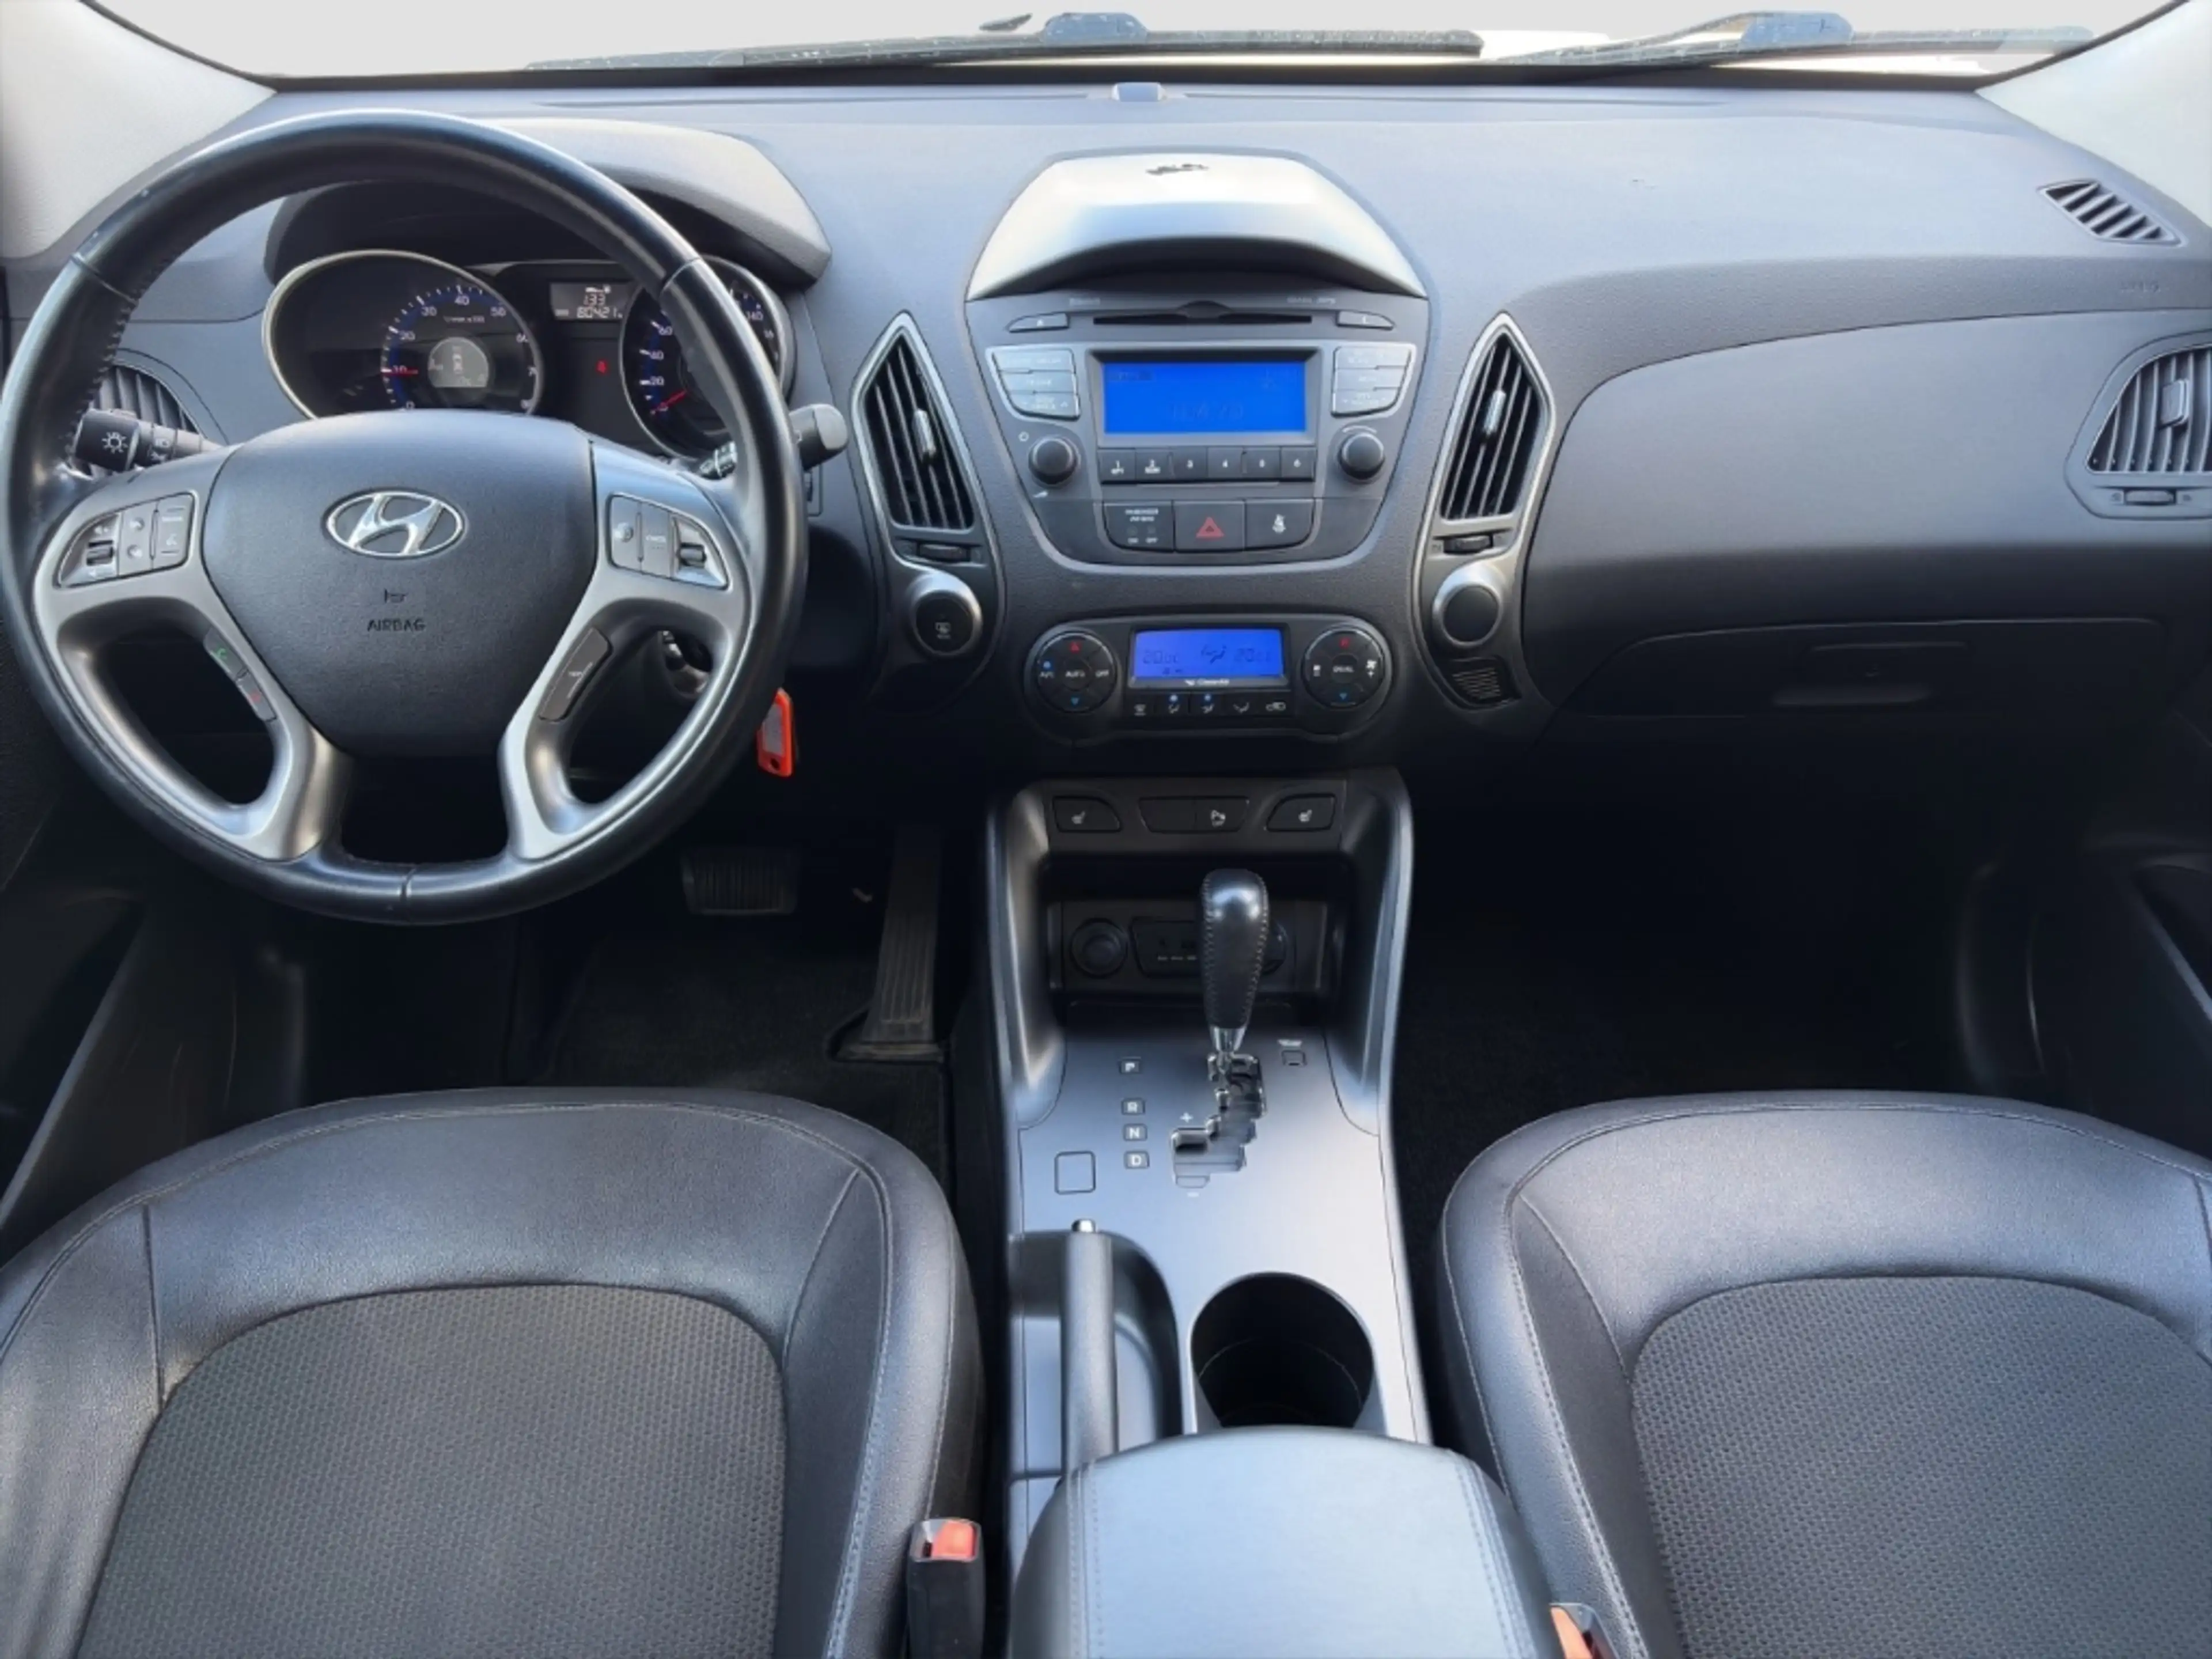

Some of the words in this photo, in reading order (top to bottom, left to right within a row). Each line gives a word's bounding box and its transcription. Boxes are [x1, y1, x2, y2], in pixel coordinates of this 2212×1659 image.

[454, 296, 469, 305] 40
[421, 307, 437, 316] 30
[490, 306, 506, 317] 50
[399, 331, 415, 340] 20
[658, 327, 673, 336] 60
[650, 350, 664, 360] 40
[651, 376, 664, 386] 20
[367, 618, 426, 631] AIRBAG
[1124, 1062, 1135, 1072] P
[1127, 1101, 1138, 1113] R
[1129, 1127, 1140, 1139] N
[1131, 1154, 1142, 1167] D
